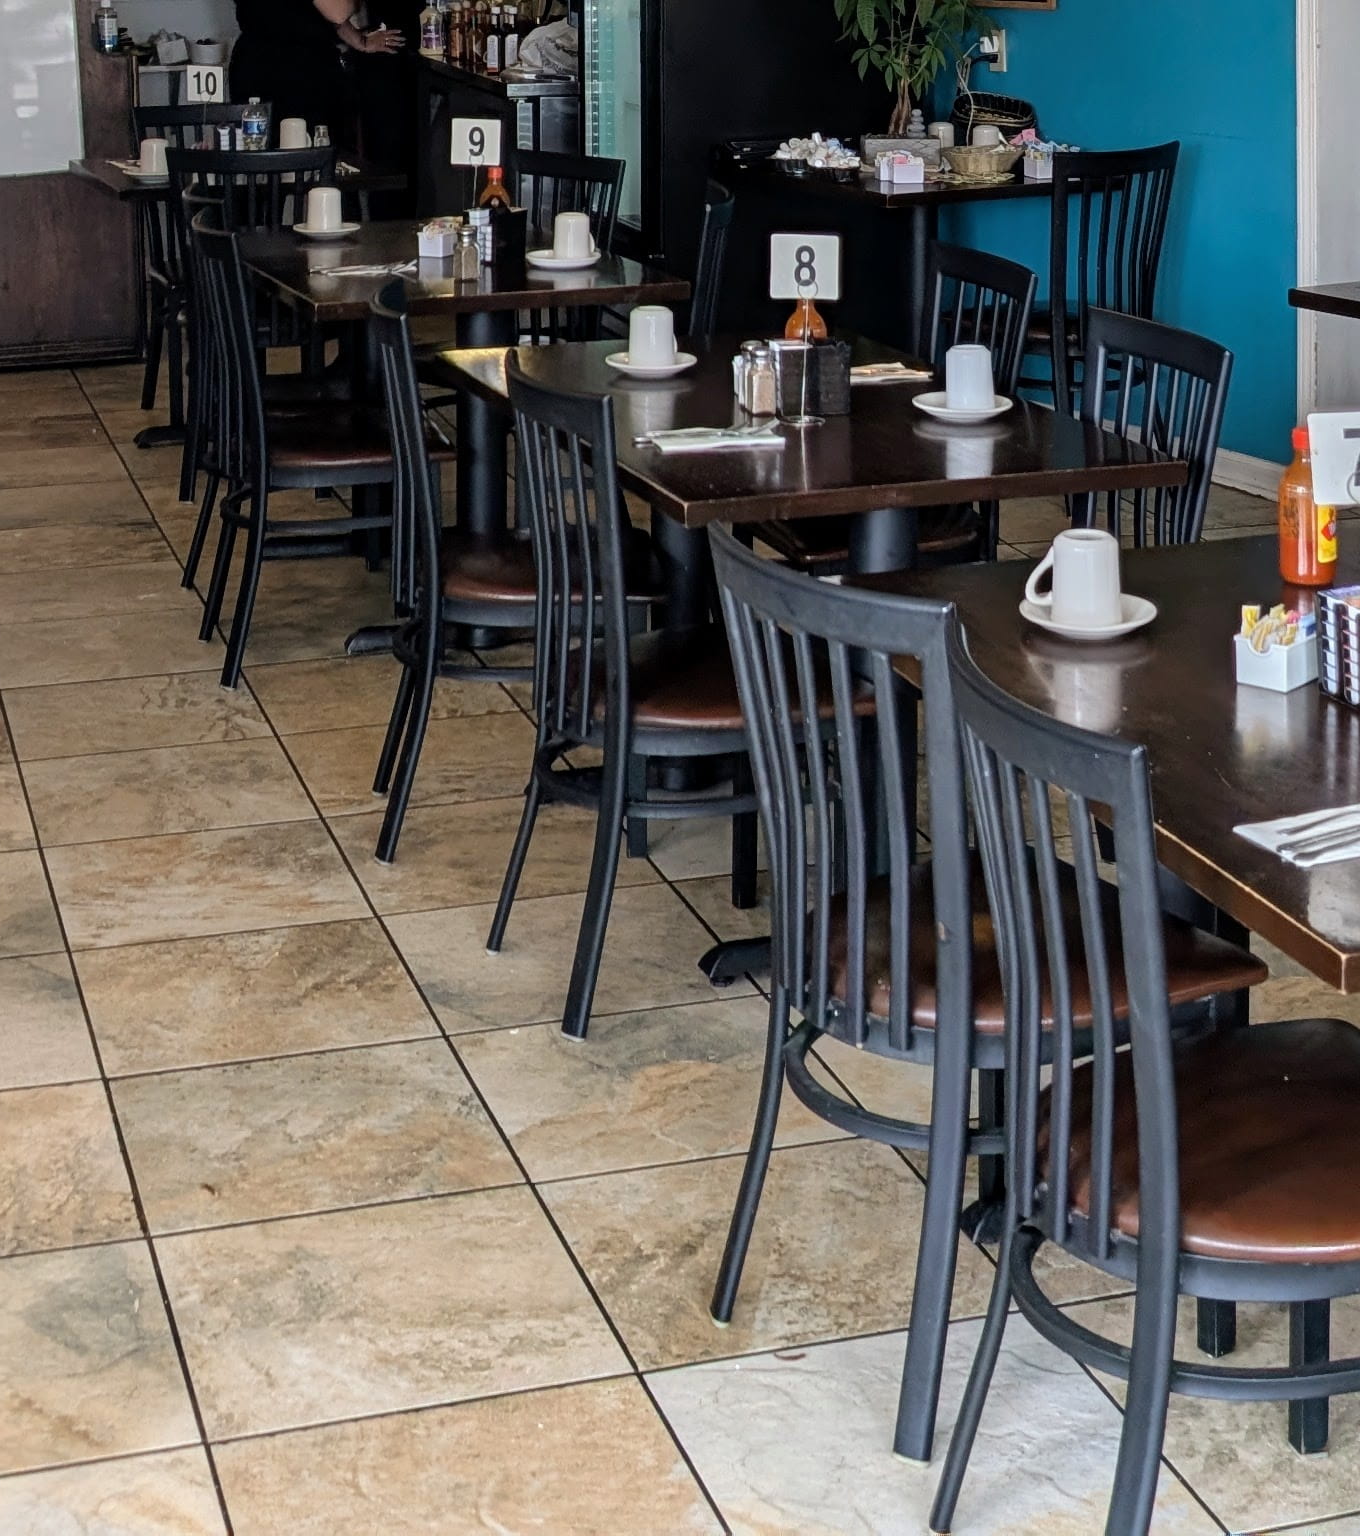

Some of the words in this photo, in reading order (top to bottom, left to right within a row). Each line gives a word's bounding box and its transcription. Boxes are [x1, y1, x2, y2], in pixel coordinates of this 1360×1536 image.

[192, 70, 218, 97] 10
[468, 126, 485, 157] 9
[793, 244, 817, 287] 8
